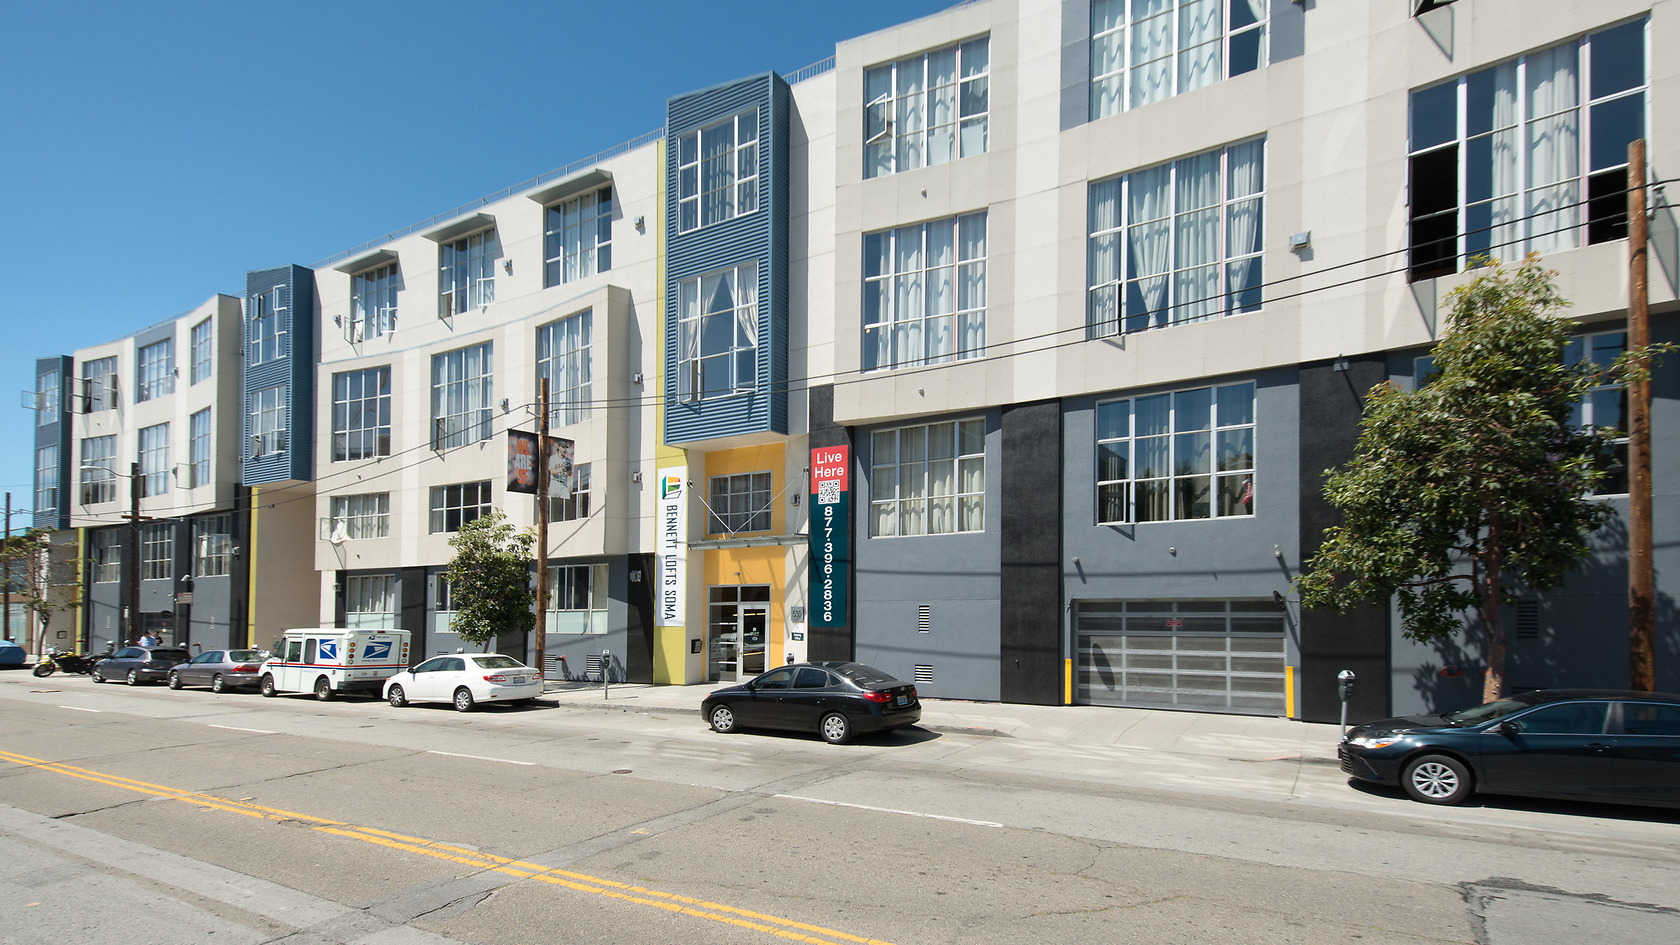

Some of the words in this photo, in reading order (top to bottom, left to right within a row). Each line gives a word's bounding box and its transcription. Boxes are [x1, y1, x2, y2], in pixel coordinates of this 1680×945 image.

[516, 439, 531, 455] WE
[515, 454, 532, 470] ARE
[817, 452, 842, 464] Live
[814, 466, 844, 478] Here
[666, 505, 678, 549] BENNETT
[665, 554, 677, 586] LOFTS
[664, 590, 677, 620] SOMA
